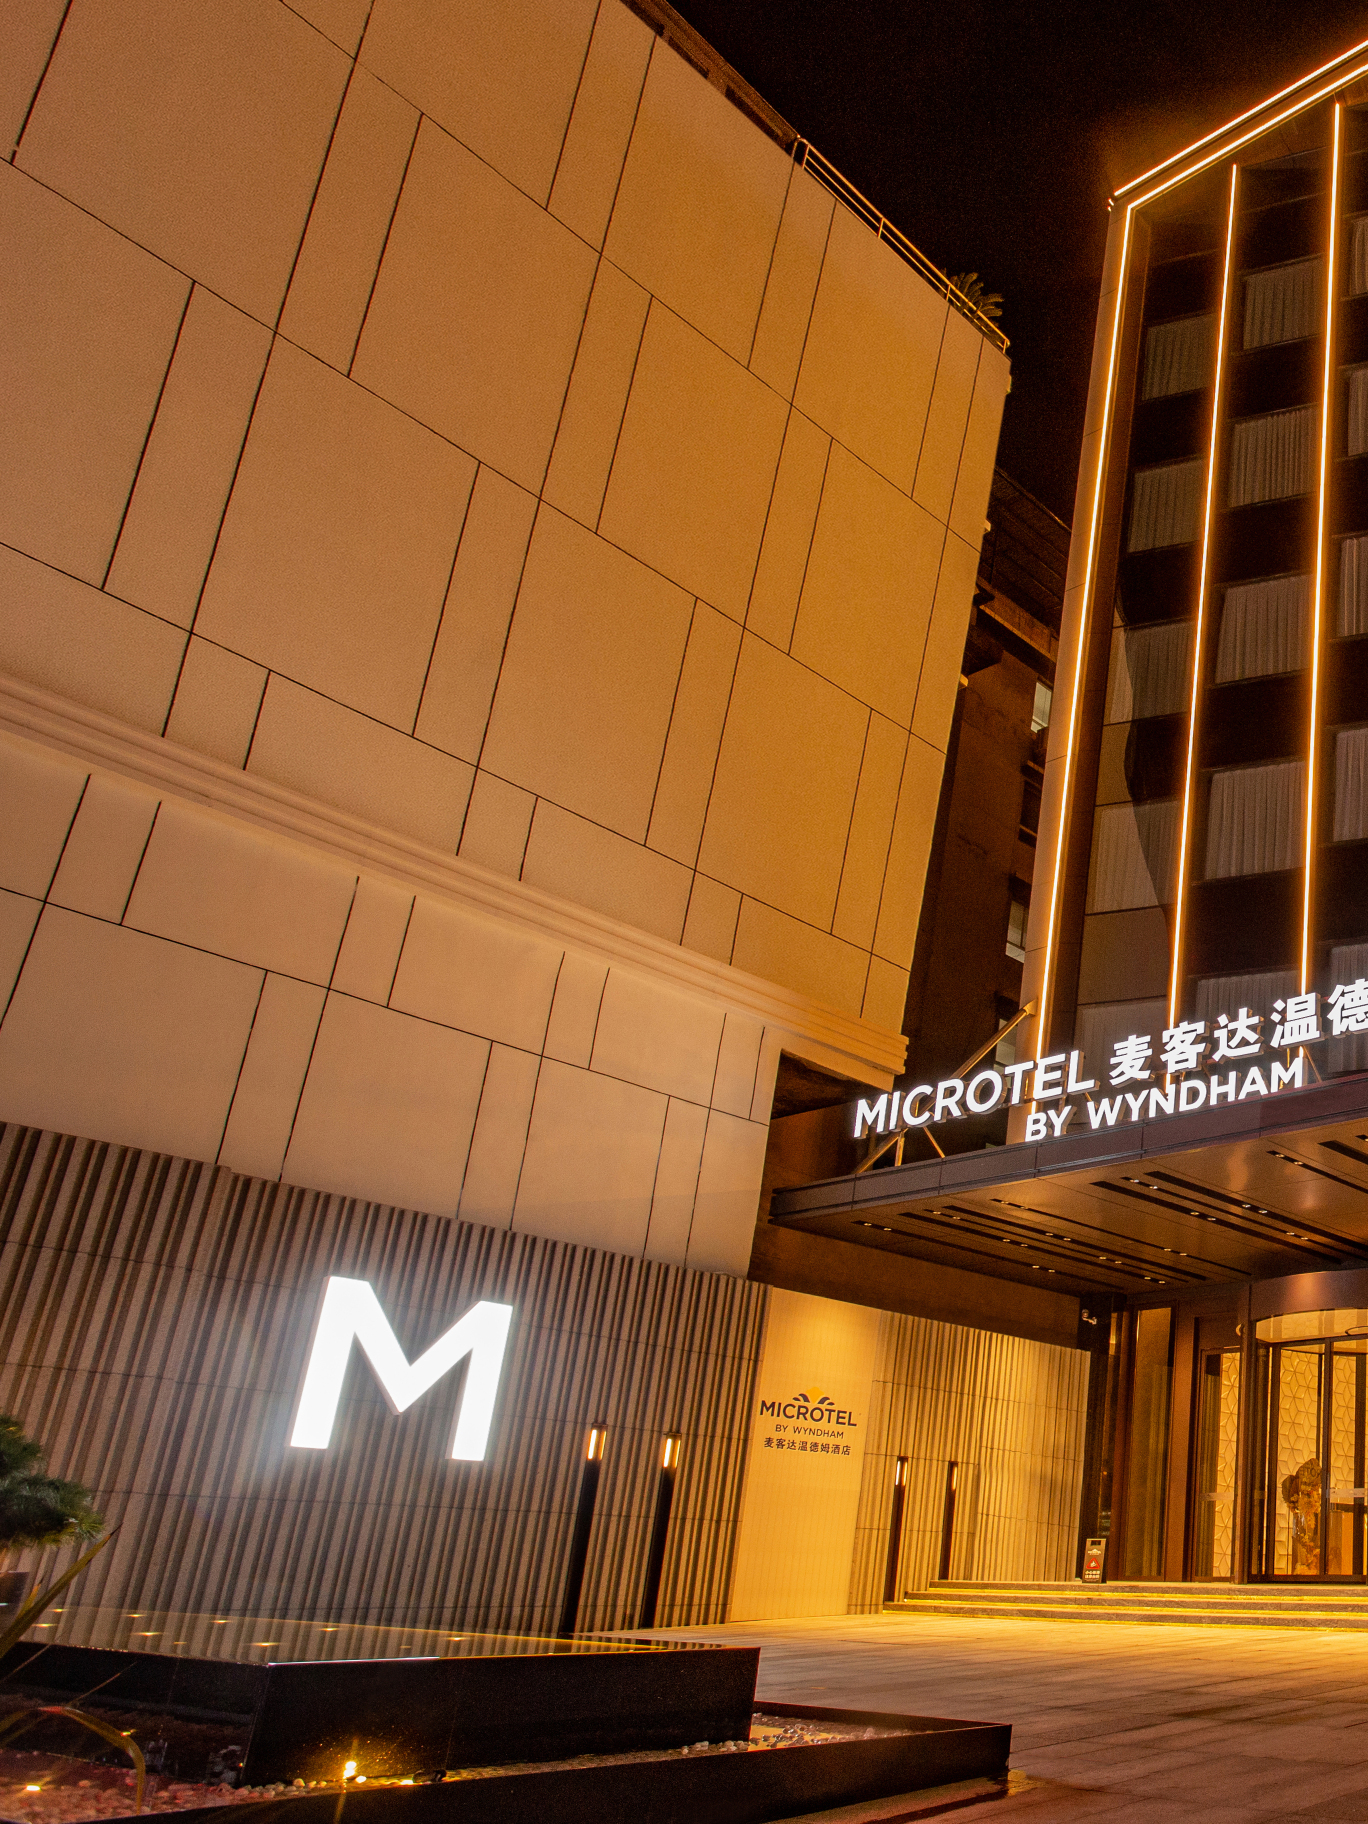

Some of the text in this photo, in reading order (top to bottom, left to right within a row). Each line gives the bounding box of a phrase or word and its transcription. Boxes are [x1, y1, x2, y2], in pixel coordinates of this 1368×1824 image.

[852, 1050, 1096, 1139] MICROTEL
[1024, 1057, 1305, 1142] BY WYNDHAM
[289, 1275, 514, 1462] M
[759, 1400, 858, 1427] MICROTEL
[775, 1424, 844, 1440] BY WYNDHAM
[764, 1437, 852, 1456] 麦客达温德姆酒店
